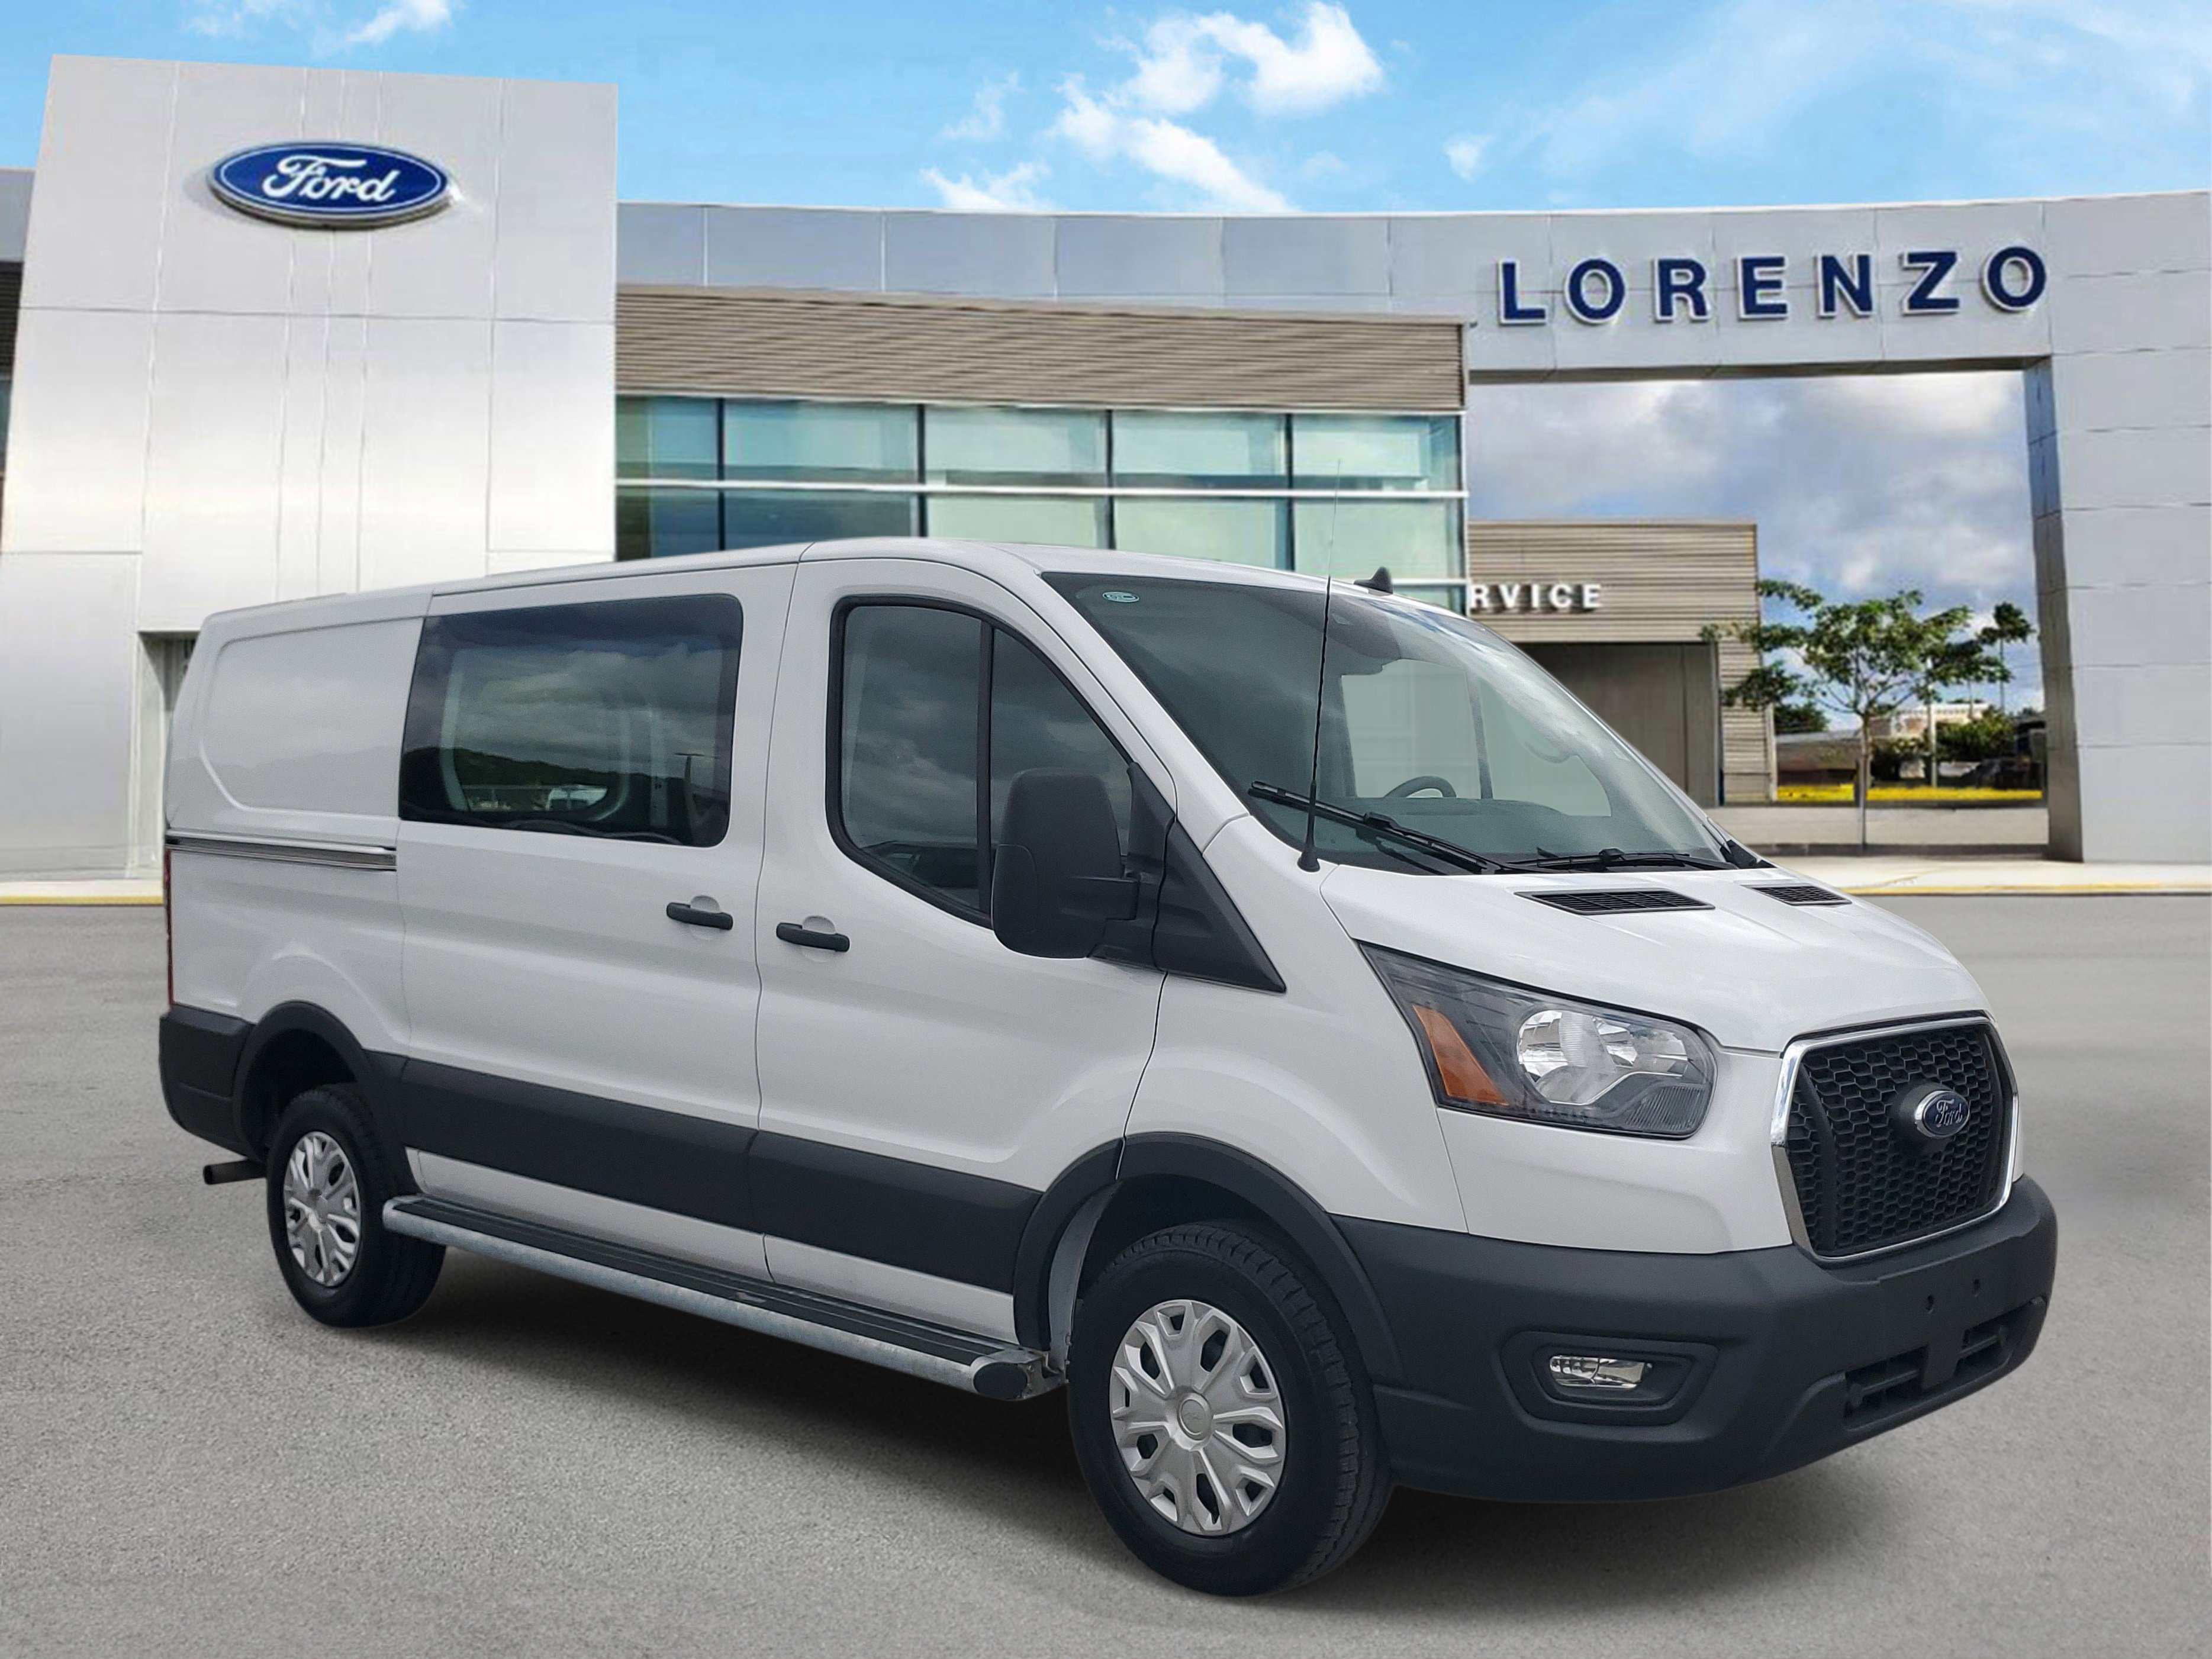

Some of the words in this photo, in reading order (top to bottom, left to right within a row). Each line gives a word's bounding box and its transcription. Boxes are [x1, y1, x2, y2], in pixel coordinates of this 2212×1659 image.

[262, 154, 400, 201] Ford
[1498, 246, 2047, 325] LORENZO
[1470, 584, 1602, 609] RVICE
[1935, 1099, 1963, 1128] Ford
